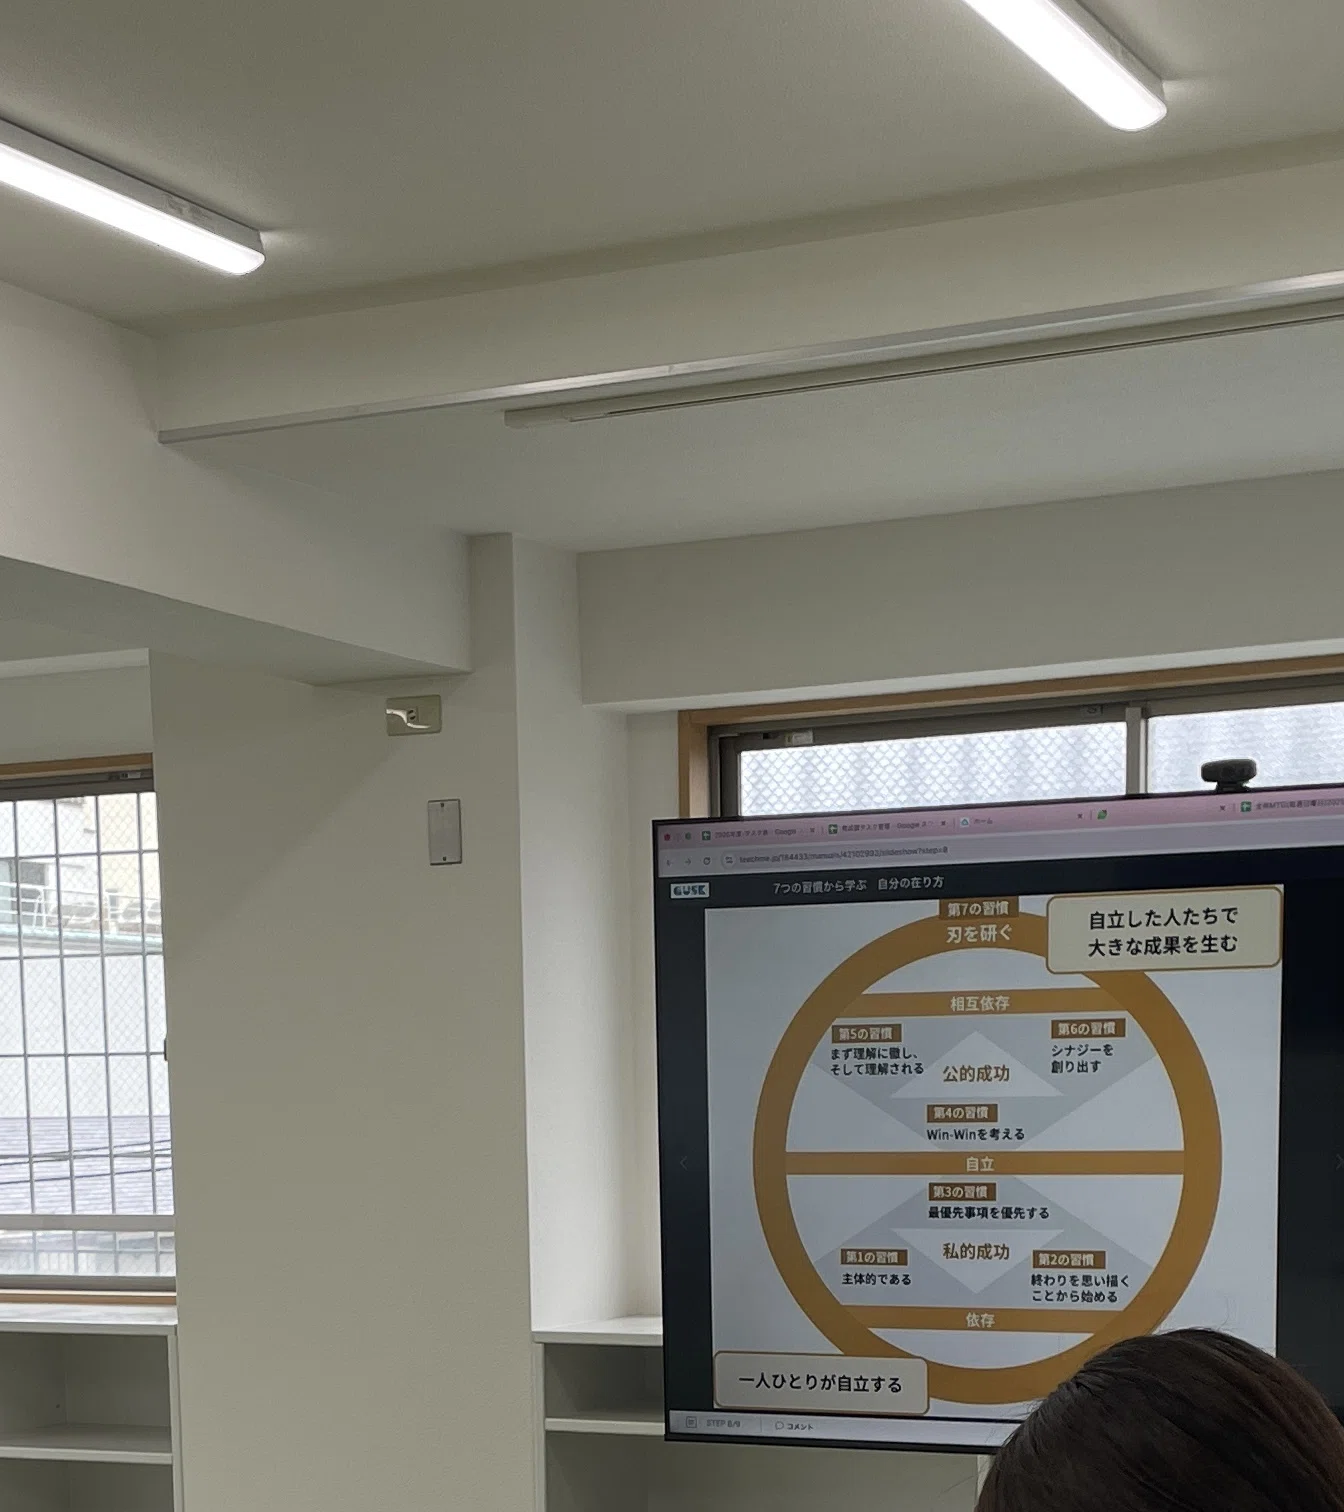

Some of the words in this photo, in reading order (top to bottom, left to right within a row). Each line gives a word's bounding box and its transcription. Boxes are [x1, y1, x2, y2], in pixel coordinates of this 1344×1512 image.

[773, 879, 867, 895] 7つの習慣から学ぶ
[878, 875, 945, 890] 自分の在り方
[947, 900, 1009, 917] 第7の習慣
[1089, 906, 1239, 930] 自立した人たちで
[946, 923, 1012, 943] 刃を研ぐ
[1088, 933, 1238, 958] 大きな成果を生む
[950, 995, 1010, 1013] 相互依存
[839, 1027, 893, 1040] 第5の習慣
[1058, 1022, 1116, 1036] 第6の習慣
[1051, 1044, 1113, 1057] シナジーを
[830, 1062, 924, 1076] そして理解される
[942, 1064, 1010, 1082] 公的成功
[1051, 1060, 1102, 1074] 創り出す
[933, 1106, 989, 1119] 第4の習慣
[927, 1128, 1025, 1141] Win-Winを考える
[966, 1156, 995, 1172] 自立
[933, 1185, 988, 1199] 第3の習慣
[928, 1206, 1050, 1220] 最優先事項を優先する
[846, 1251, 899, 1264] 第1の習慣
[942, 1242, 1010, 1260] 私的成功
[1038, 1253, 1094, 1266] 第2の習慣
[842, 1273, 912, 1286] 主体的である
[1031, 1274, 1130, 1288] 終わりを思い描く
[1032, 1290, 1118, 1303] ことから始める
[966, 1312, 996, 1328] 依存
[738, 1372, 903, 1393] 一人ひとりが自立する
[787, 1423, 814, 1431] コメント
